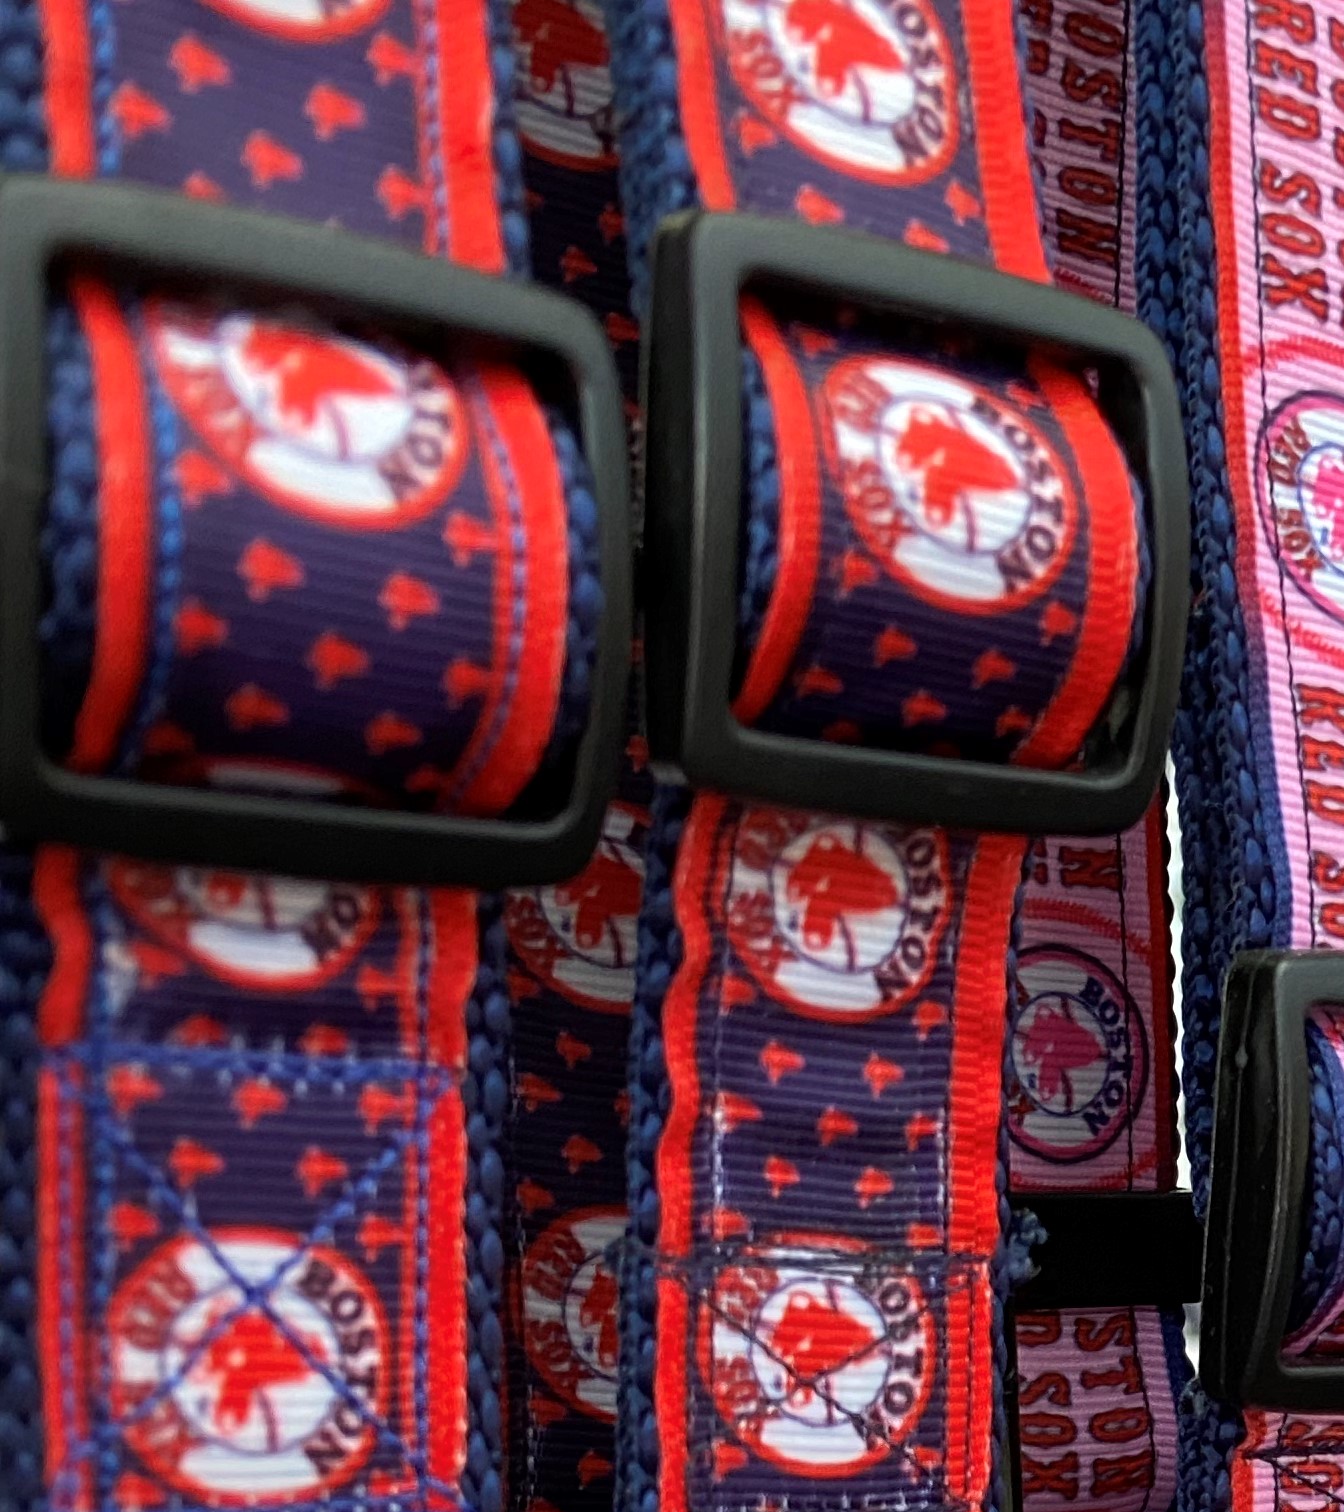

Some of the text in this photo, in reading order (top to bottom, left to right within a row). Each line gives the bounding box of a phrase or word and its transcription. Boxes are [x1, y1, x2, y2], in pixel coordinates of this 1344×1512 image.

[890, 6, 946, 170] OSTON
[1055, 2, 1123, 268] OSTON
[1257, 157, 1331, 326] SOX
[972, 396, 1066, 598] BOSTON
[1267, 414, 1326, 584] RED SOX
[1080, 976, 1134, 1137] BOSTON
[1073, 1310, 1156, 1500] STON
